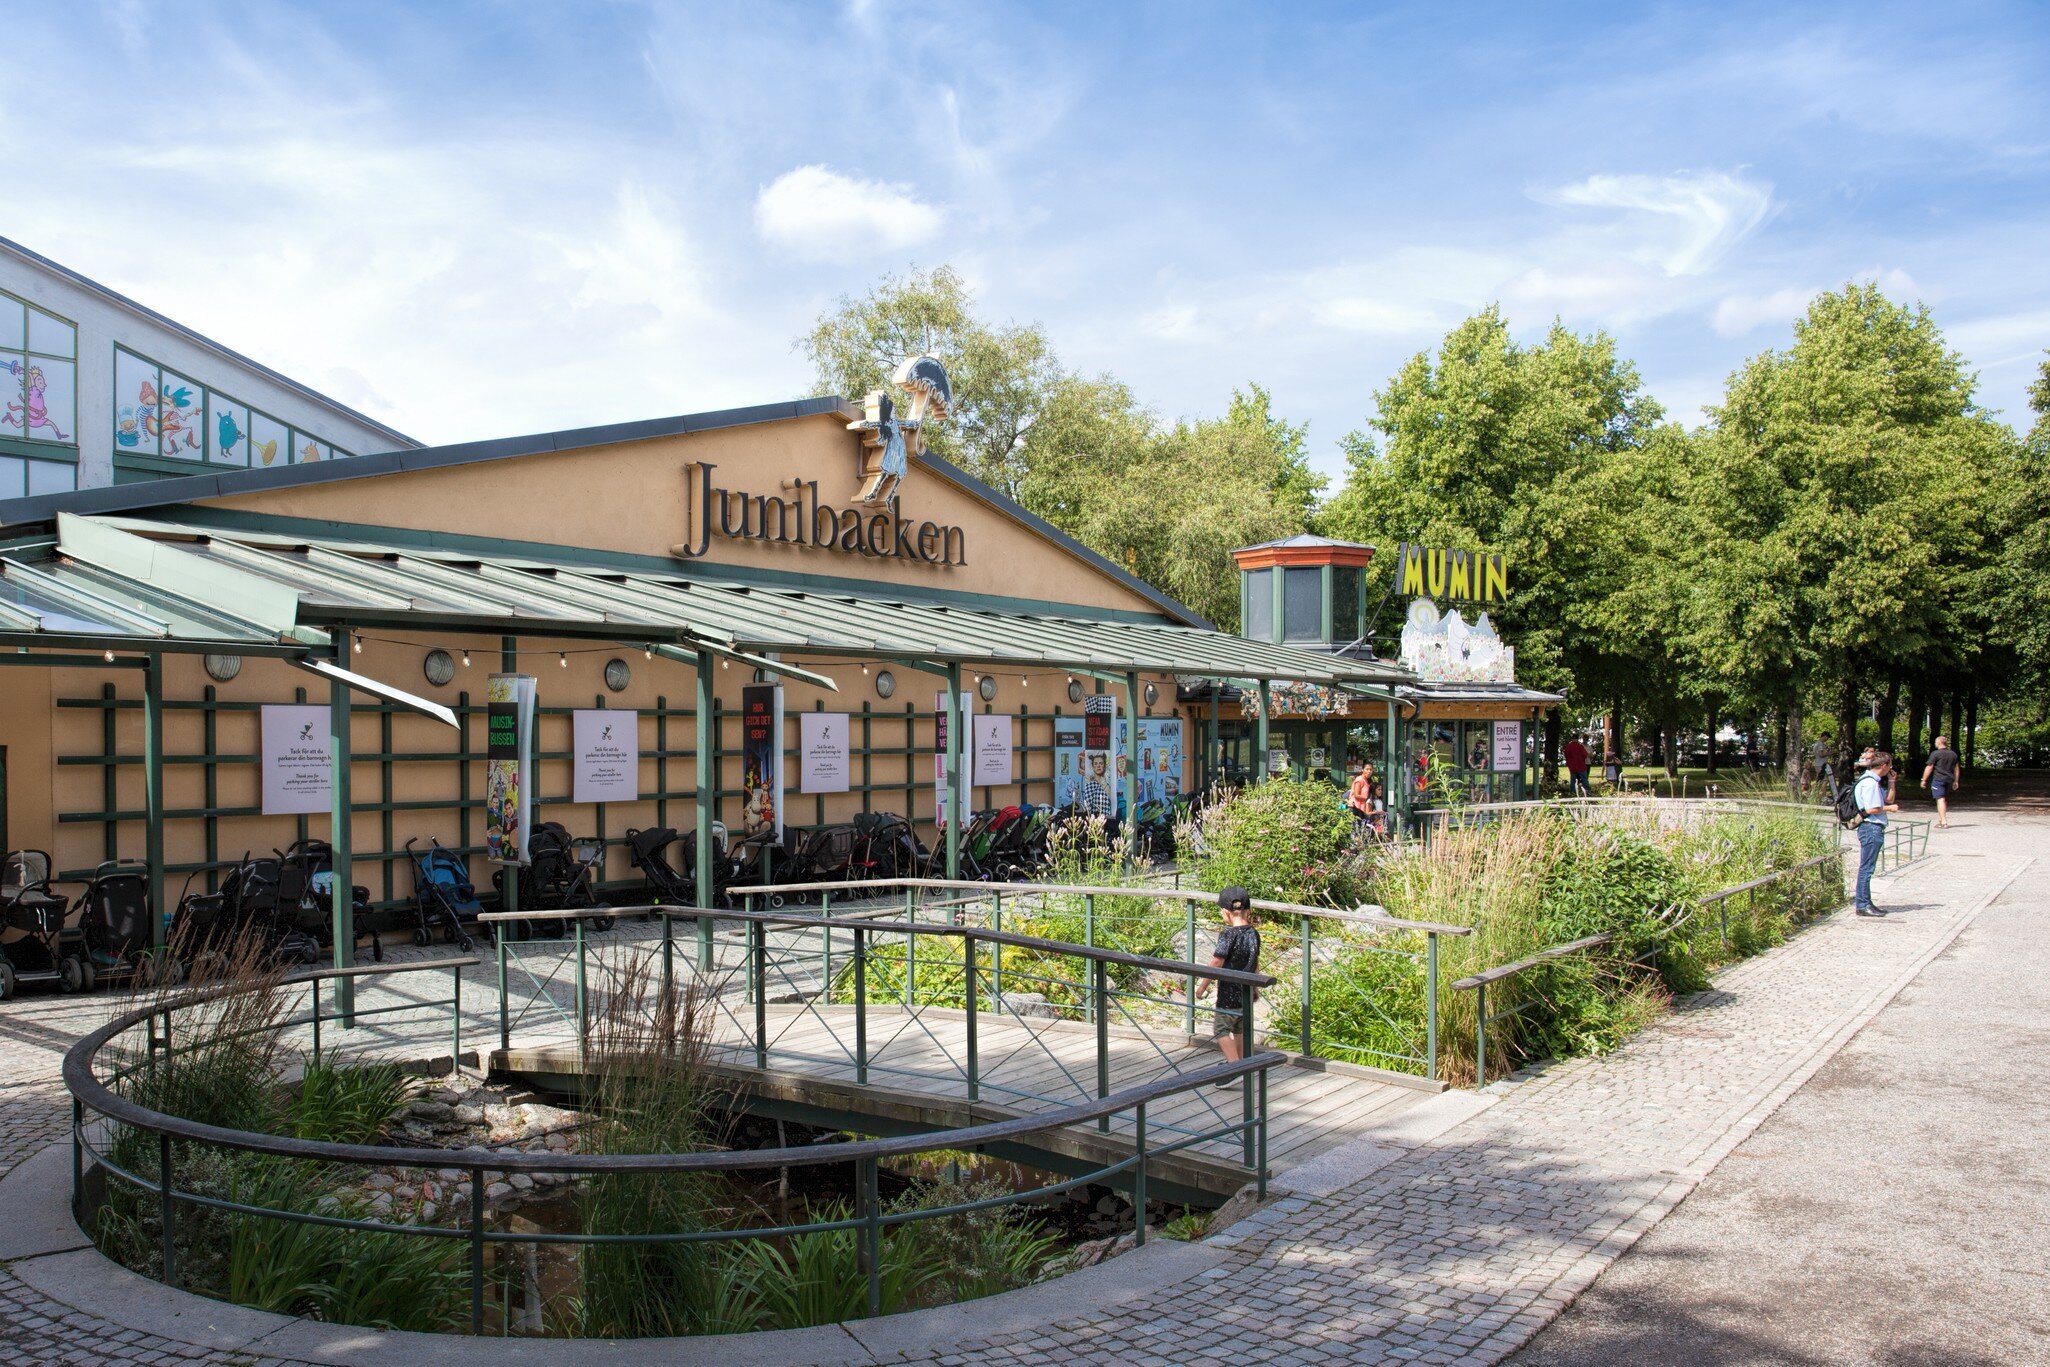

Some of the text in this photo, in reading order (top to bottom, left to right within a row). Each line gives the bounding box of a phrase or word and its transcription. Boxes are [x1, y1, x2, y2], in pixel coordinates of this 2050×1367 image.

[681, 461, 968, 567] Junibacken
[1401, 546, 1507, 602] MUMIN
[490, 715, 515, 729] MUSIK-
[1088, 717, 1100, 726] VEM
[1496, 724, 1518, 736] ENTRÉ
[490, 732, 515, 746] BUSSEN
[278, 755, 297, 763] parkerar
[306, 755, 327, 763] barnvagn
